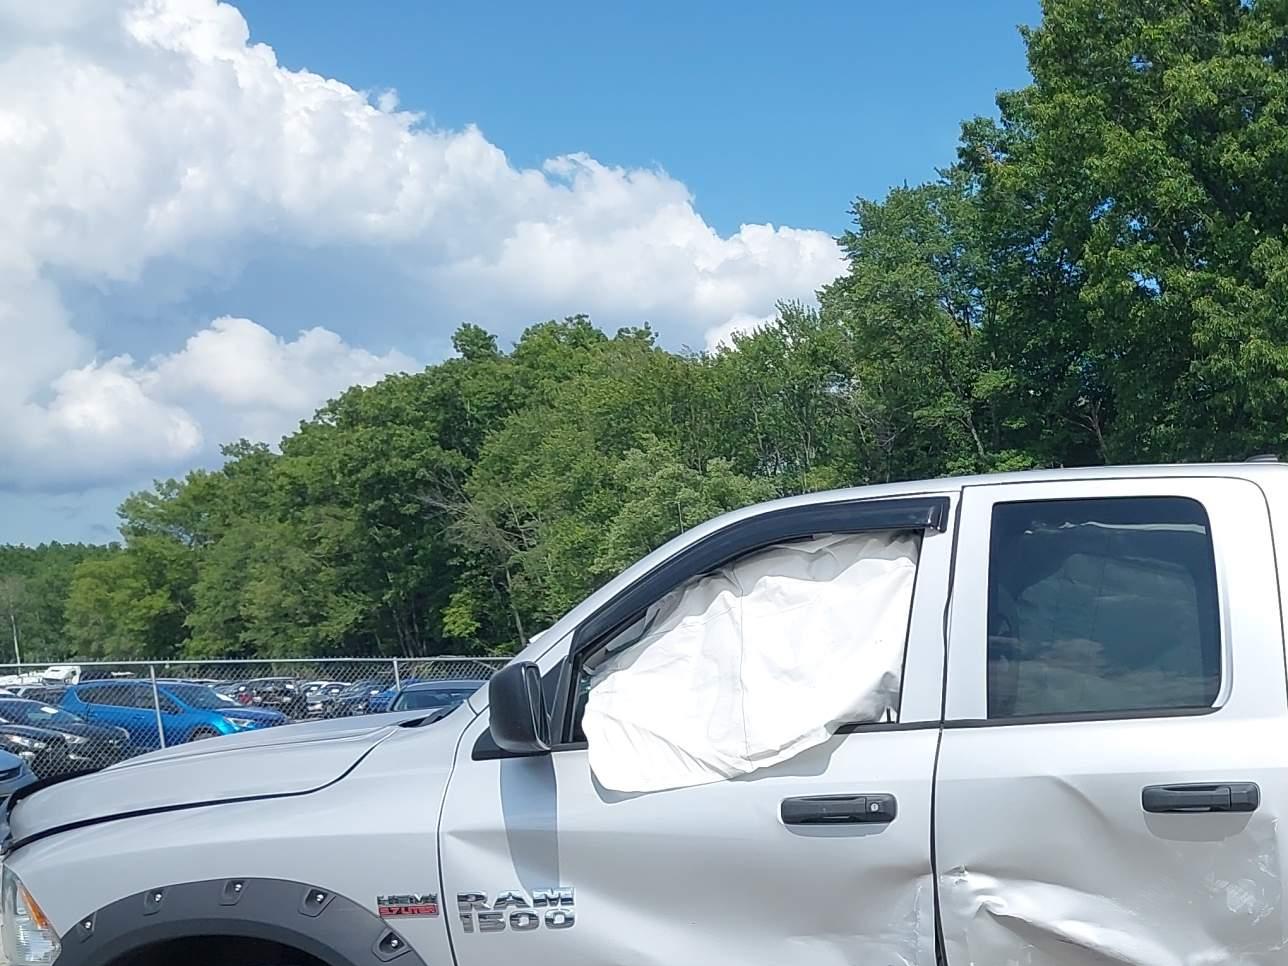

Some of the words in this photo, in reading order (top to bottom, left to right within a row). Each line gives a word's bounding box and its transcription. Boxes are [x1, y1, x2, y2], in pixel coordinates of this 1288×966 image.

[376, 893, 438, 904] HEMI
[457, 888, 575, 911] RAM
[459, 908, 576, 934] 1500
